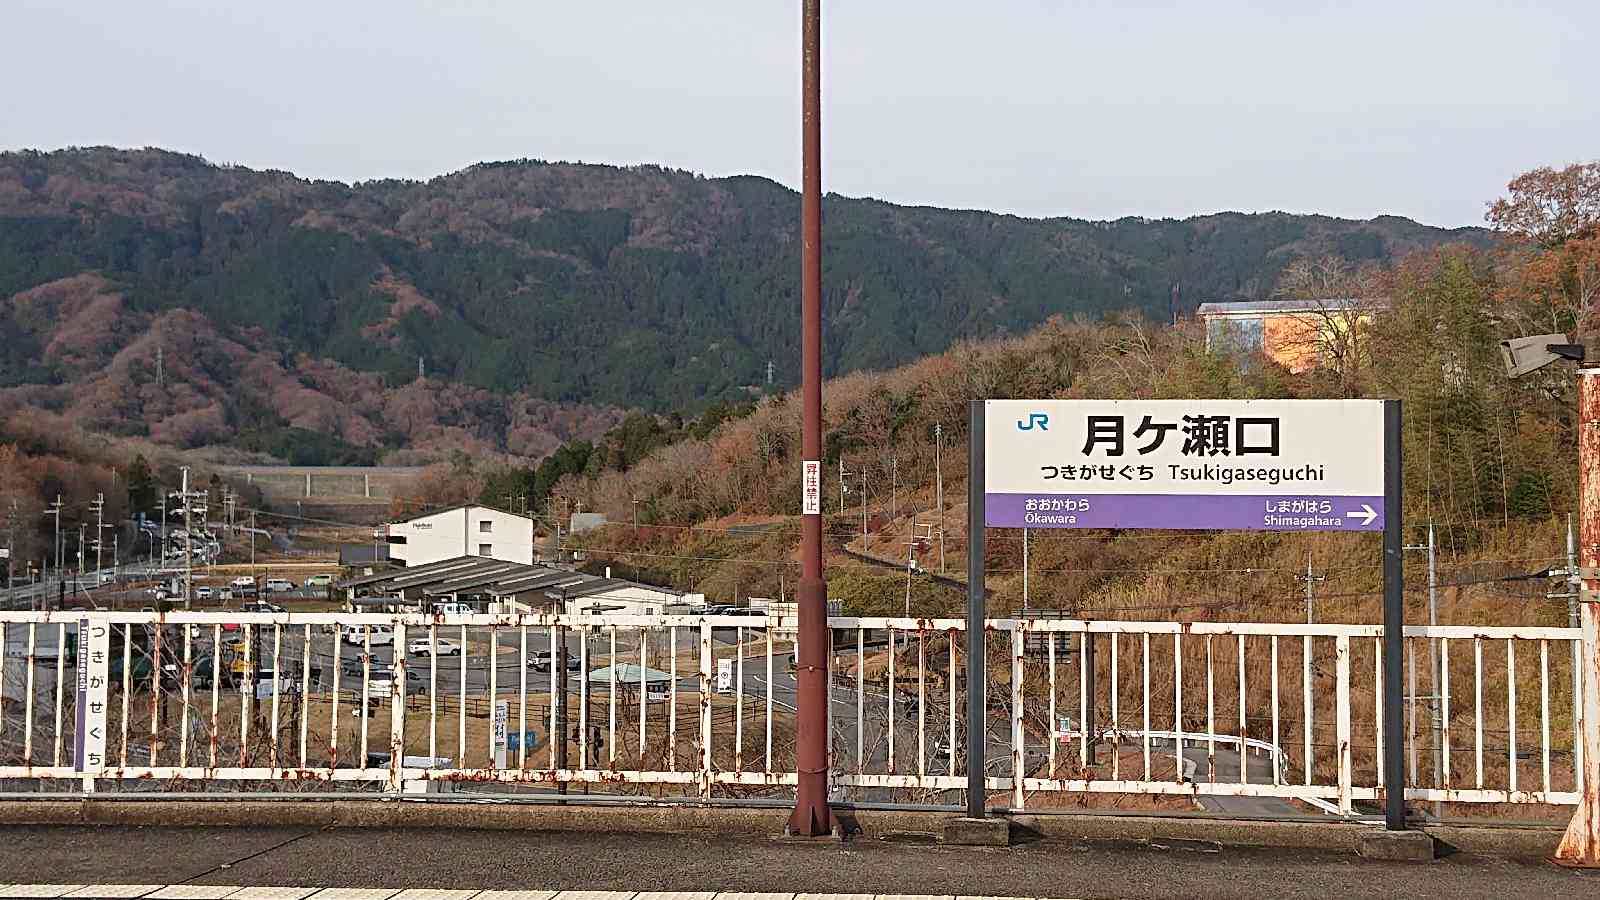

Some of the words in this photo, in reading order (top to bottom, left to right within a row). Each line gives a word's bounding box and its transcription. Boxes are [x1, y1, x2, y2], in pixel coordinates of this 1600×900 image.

[1018, 414, 1048, 431] JR
[1081, 414, 1280, 457] 月ケ瀬口
[1041, 464, 1153, 481] つきがせぐち
[1168, 463, 1324, 485] Tsukigaseguchi
[1025, 498, 1090, 511] おおかわら
[1265, 498, 1332, 513] しまがはら
[1264, 514, 1342, 529] Shimagahara
[88, 626, 106, 766] つきがせぐち
